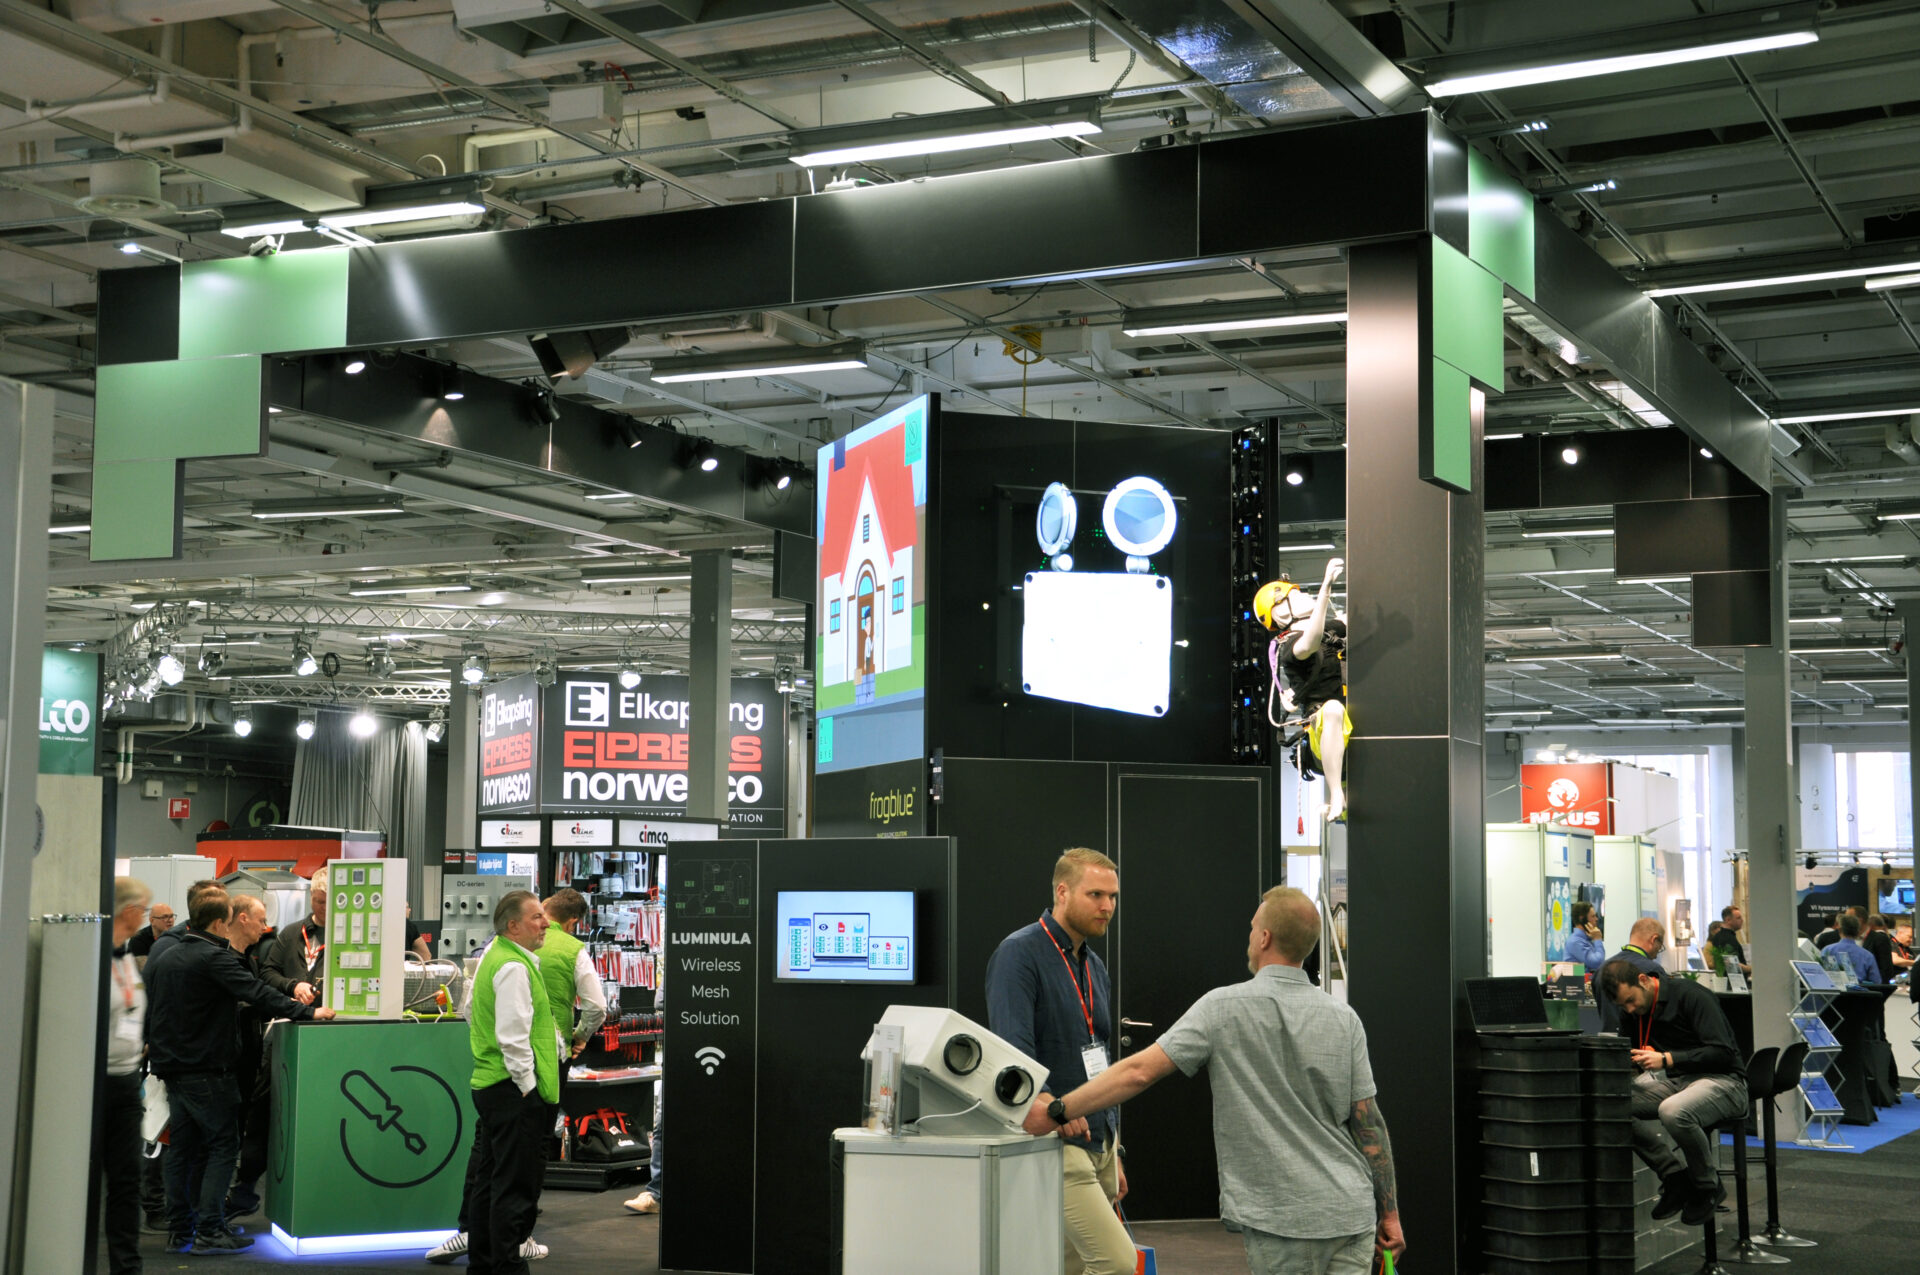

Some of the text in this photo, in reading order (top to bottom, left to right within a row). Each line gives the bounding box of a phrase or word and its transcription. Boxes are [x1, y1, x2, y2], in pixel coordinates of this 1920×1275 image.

[39, 697, 90, 734] LCO
[497, 694, 533, 731] Elkapsling
[620, 692, 763, 731] Elkapng
[564, 731, 762, 772] ELPRES
[483, 772, 531, 806] norwesco
[870, 788, 914, 824] frogblue
[639, 824, 668, 845] cimco
[672, 932, 752, 945] LUMINULA
[681, 958, 741, 972] Wireless
[691, 985, 730, 998] Mesh
[680, 1011, 740, 1025] Solution
